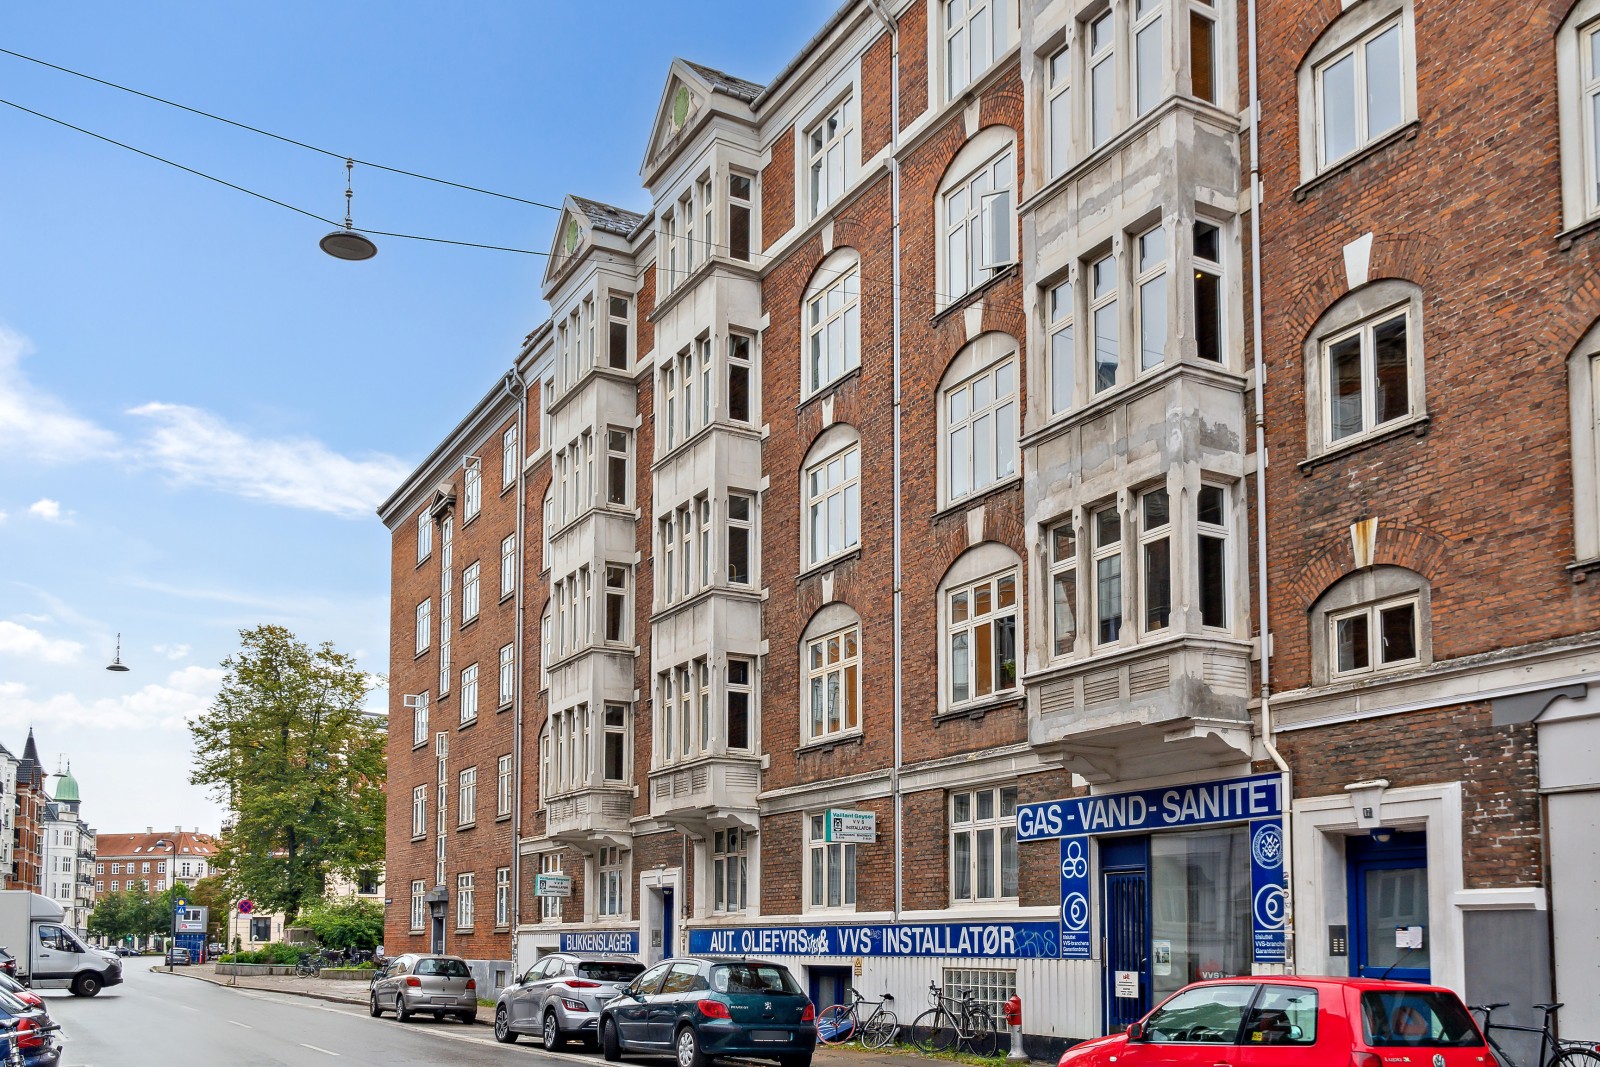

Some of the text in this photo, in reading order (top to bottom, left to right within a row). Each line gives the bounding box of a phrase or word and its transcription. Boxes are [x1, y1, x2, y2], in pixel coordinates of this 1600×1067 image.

[1017, 804, 1063, 837] GAS
[1077, 795, 1147, 830] VAND
[1162, 777, 1282, 823] SANITET
[566, 933, 632, 952] BLIKKENSLAGER
[709, 930, 737, 953] AUT.
[838, 927, 872, 954] VVS
[882, 925, 1015, 955] INSTALLATØR
